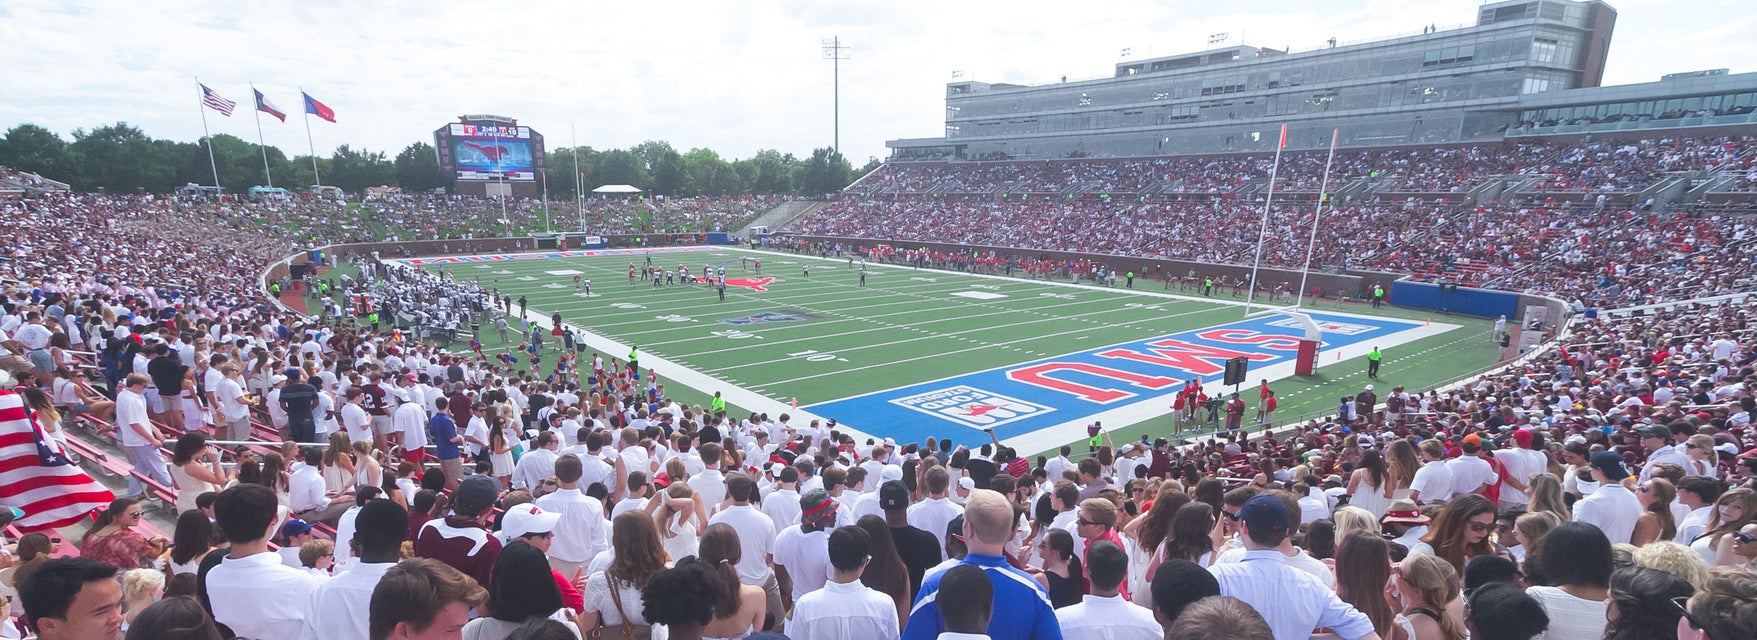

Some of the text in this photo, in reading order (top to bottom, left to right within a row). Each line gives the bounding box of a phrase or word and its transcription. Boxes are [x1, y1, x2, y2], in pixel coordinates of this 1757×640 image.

[787, 349, 836, 361] 10
[1006, 328, 1329, 404] SMU
[902, 387, 971, 405] STADIUM
[920, 391, 988, 410] FORD
